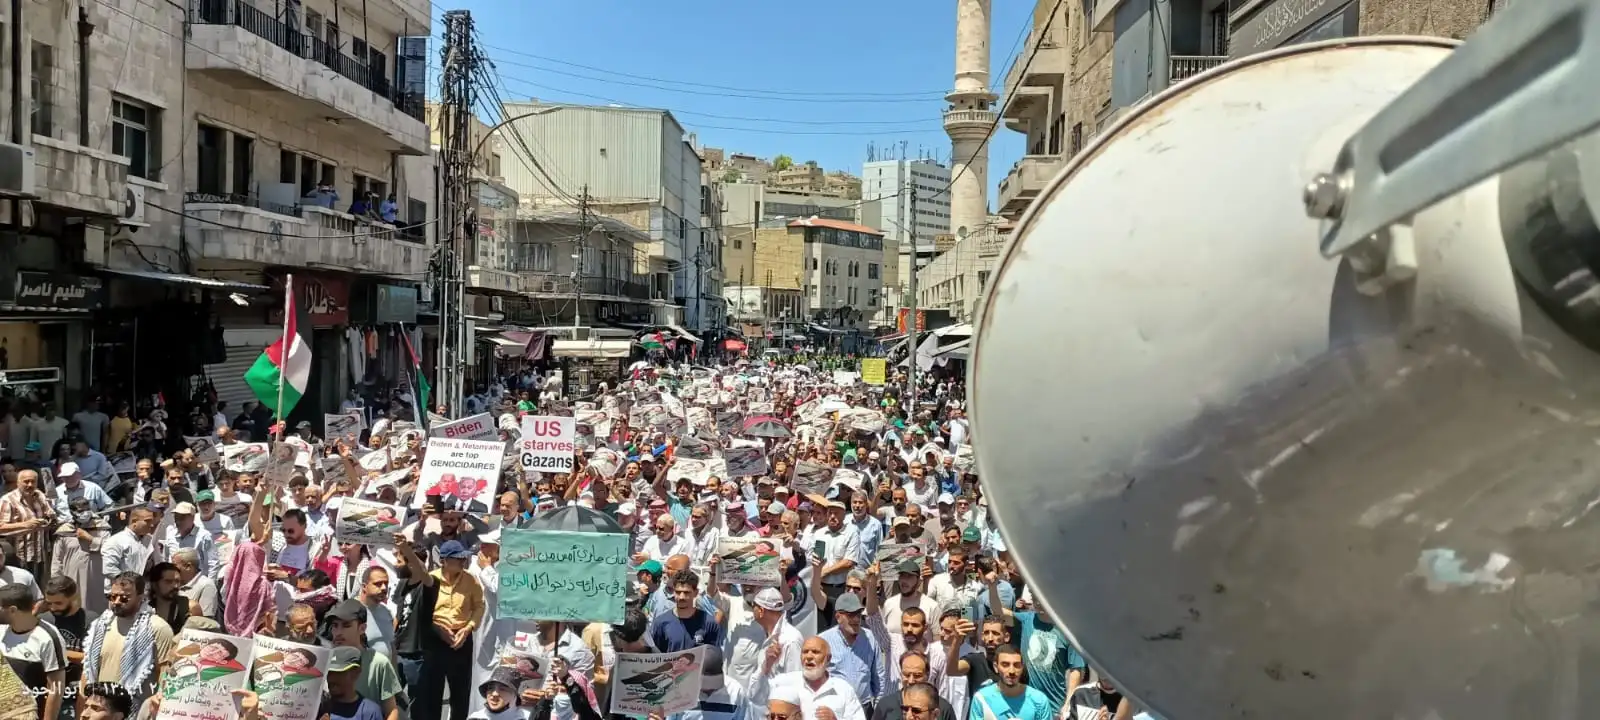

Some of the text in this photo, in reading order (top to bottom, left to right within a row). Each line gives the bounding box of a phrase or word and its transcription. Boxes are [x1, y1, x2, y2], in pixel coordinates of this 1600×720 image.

[21, 282, 52, 298] ناصر
[444, 420, 482, 438] Biden
[534, 420, 561, 437] US
[430, 440, 453, 448] Biden
[524, 440, 573, 452] starves
[466, 451, 479, 459] top
[521, 452, 573, 469] Gazans
[430, 459, 496, 470] GENOCIDAIRES
[530, 572, 546, 591] كل
